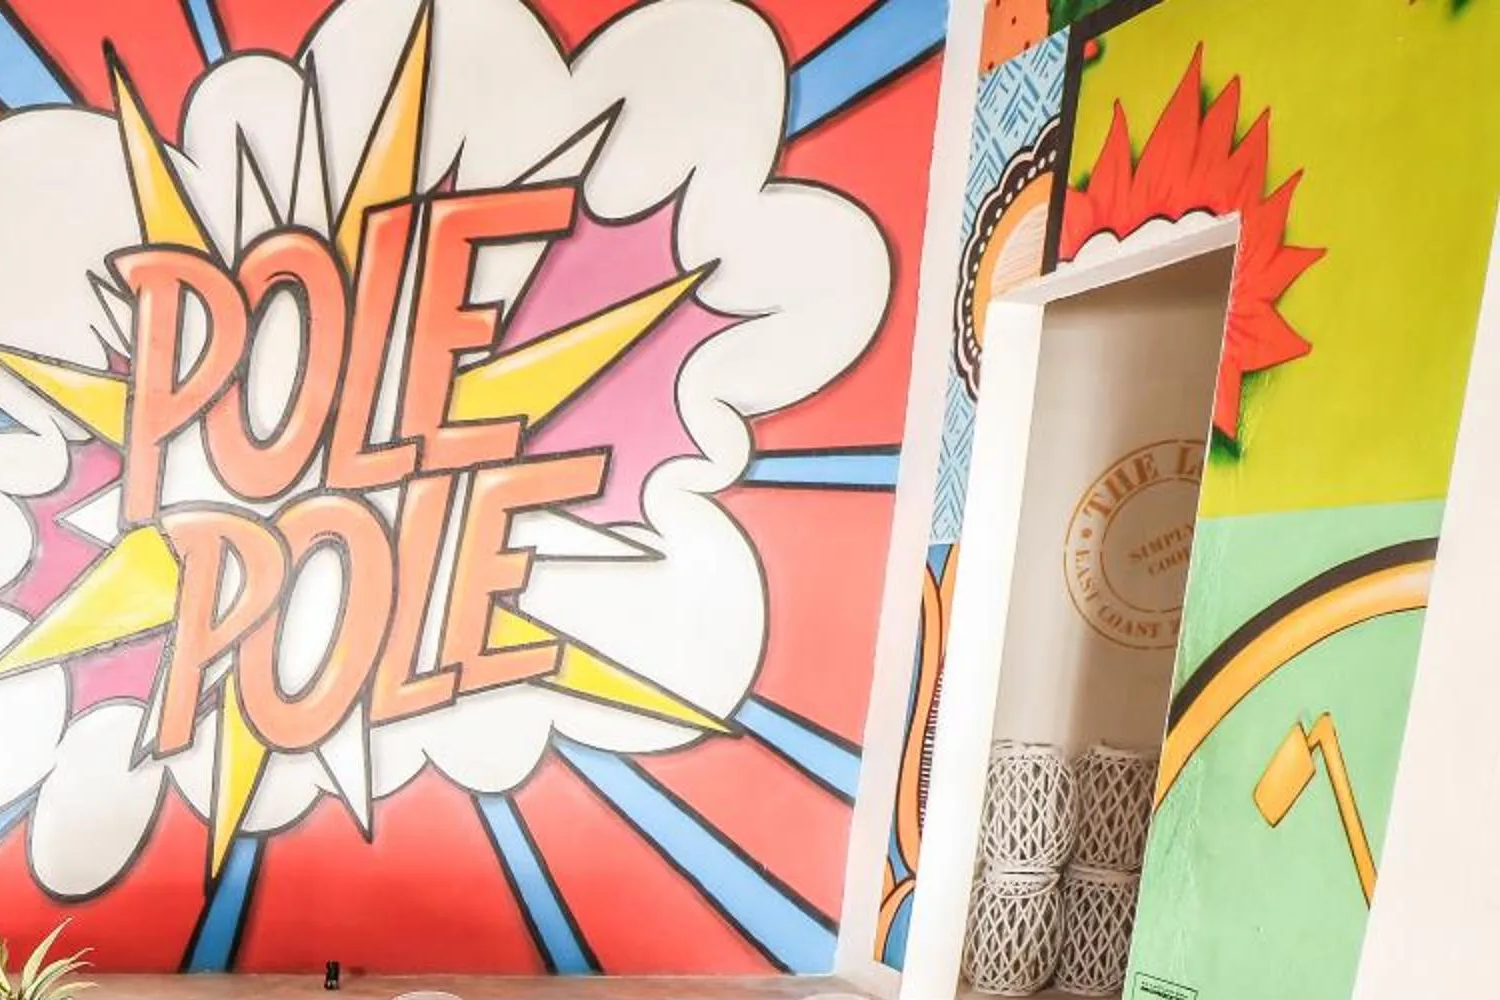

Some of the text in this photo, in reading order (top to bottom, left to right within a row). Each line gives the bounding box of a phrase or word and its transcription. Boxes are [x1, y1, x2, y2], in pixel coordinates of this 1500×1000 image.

[103, 176, 582, 536] POLE
[1082, 446, 1205, 519] THE L
[151, 445, 613, 760] POLE
[1074, 549, 1160, 639] EAST COAST
